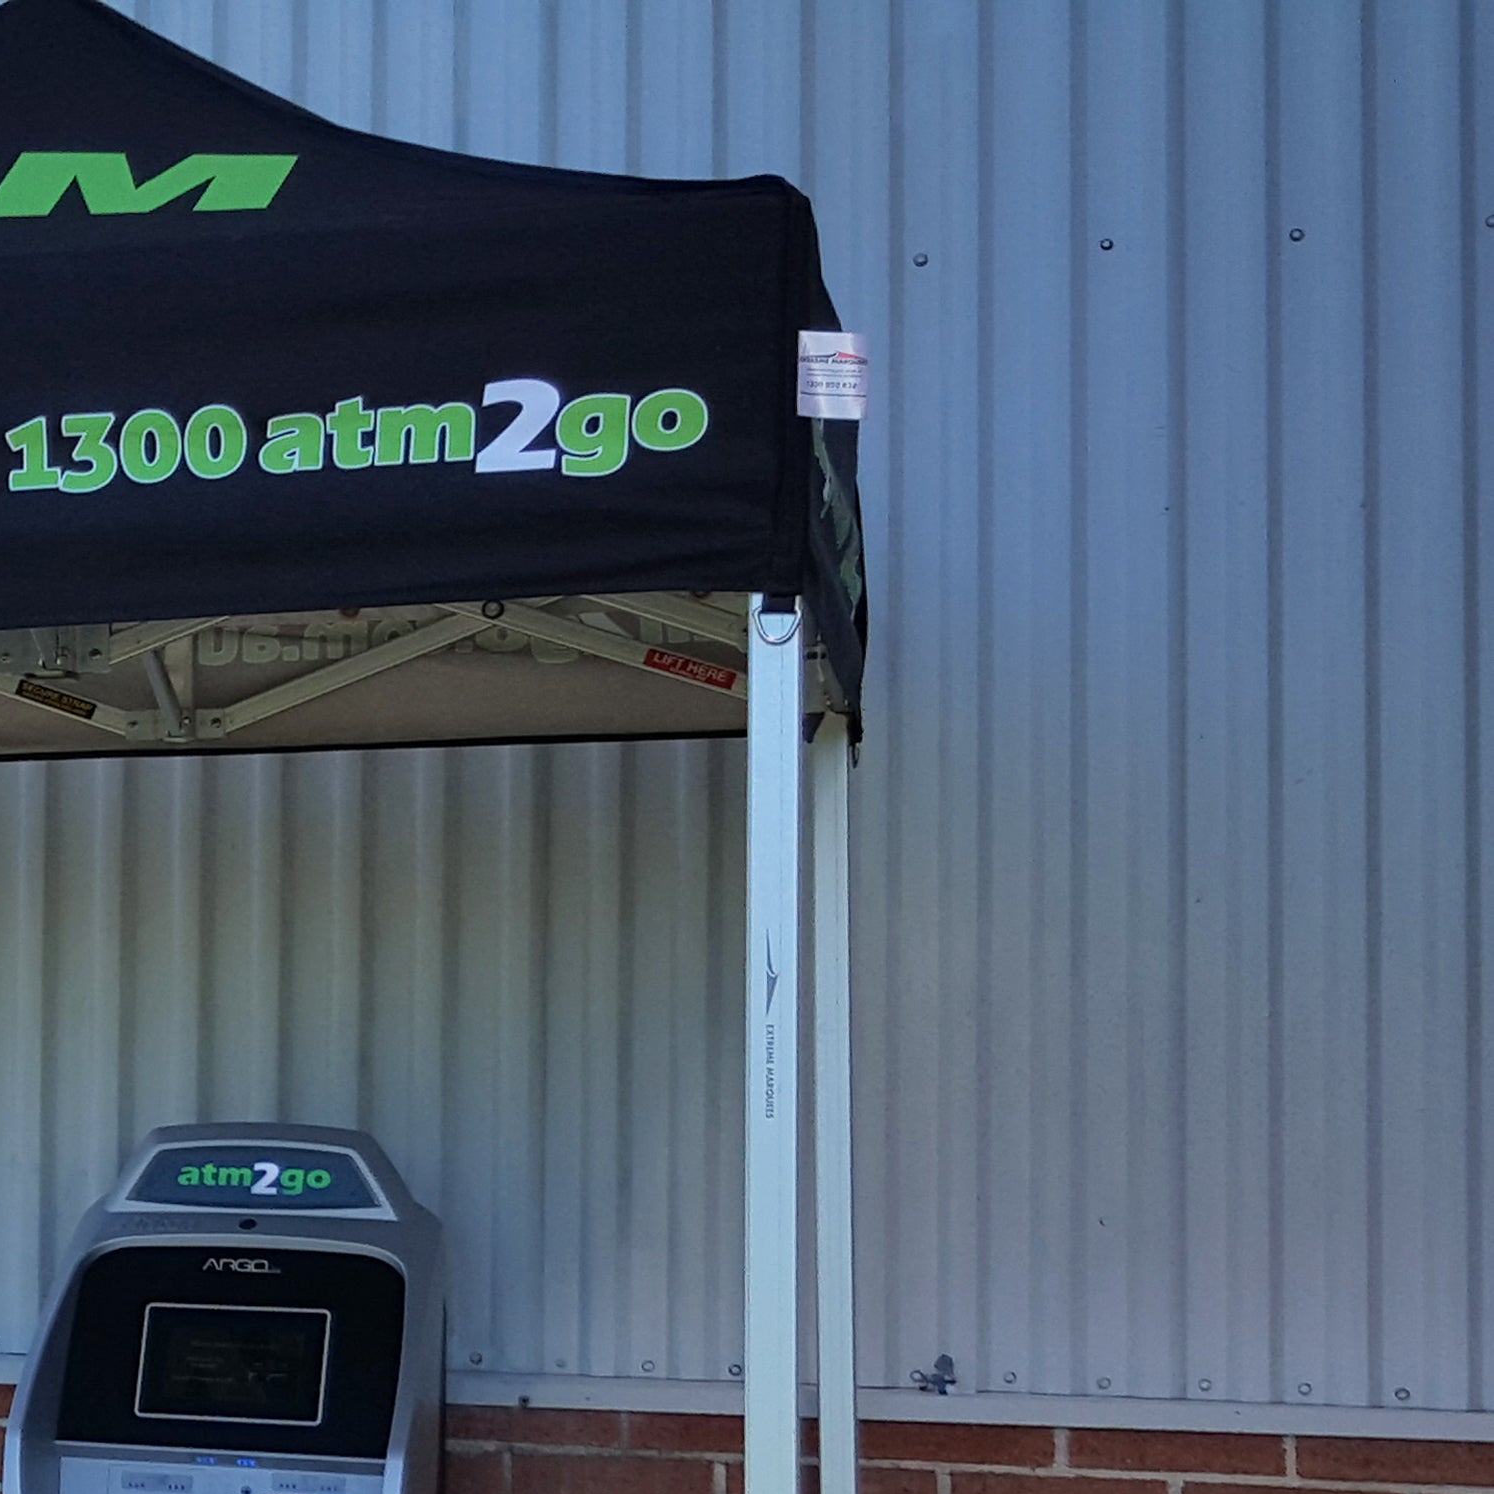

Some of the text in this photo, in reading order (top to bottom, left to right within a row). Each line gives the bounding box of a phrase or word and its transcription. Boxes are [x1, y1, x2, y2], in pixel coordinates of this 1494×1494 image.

[5, 378, 710, 495] 1300 atm2go
[652, 651, 685, 671] LIFT
[685, 660, 728, 683] HERE
[177, 1161, 332, 1195] atm2go
[201, 1257, 271, 1273] ARGO
